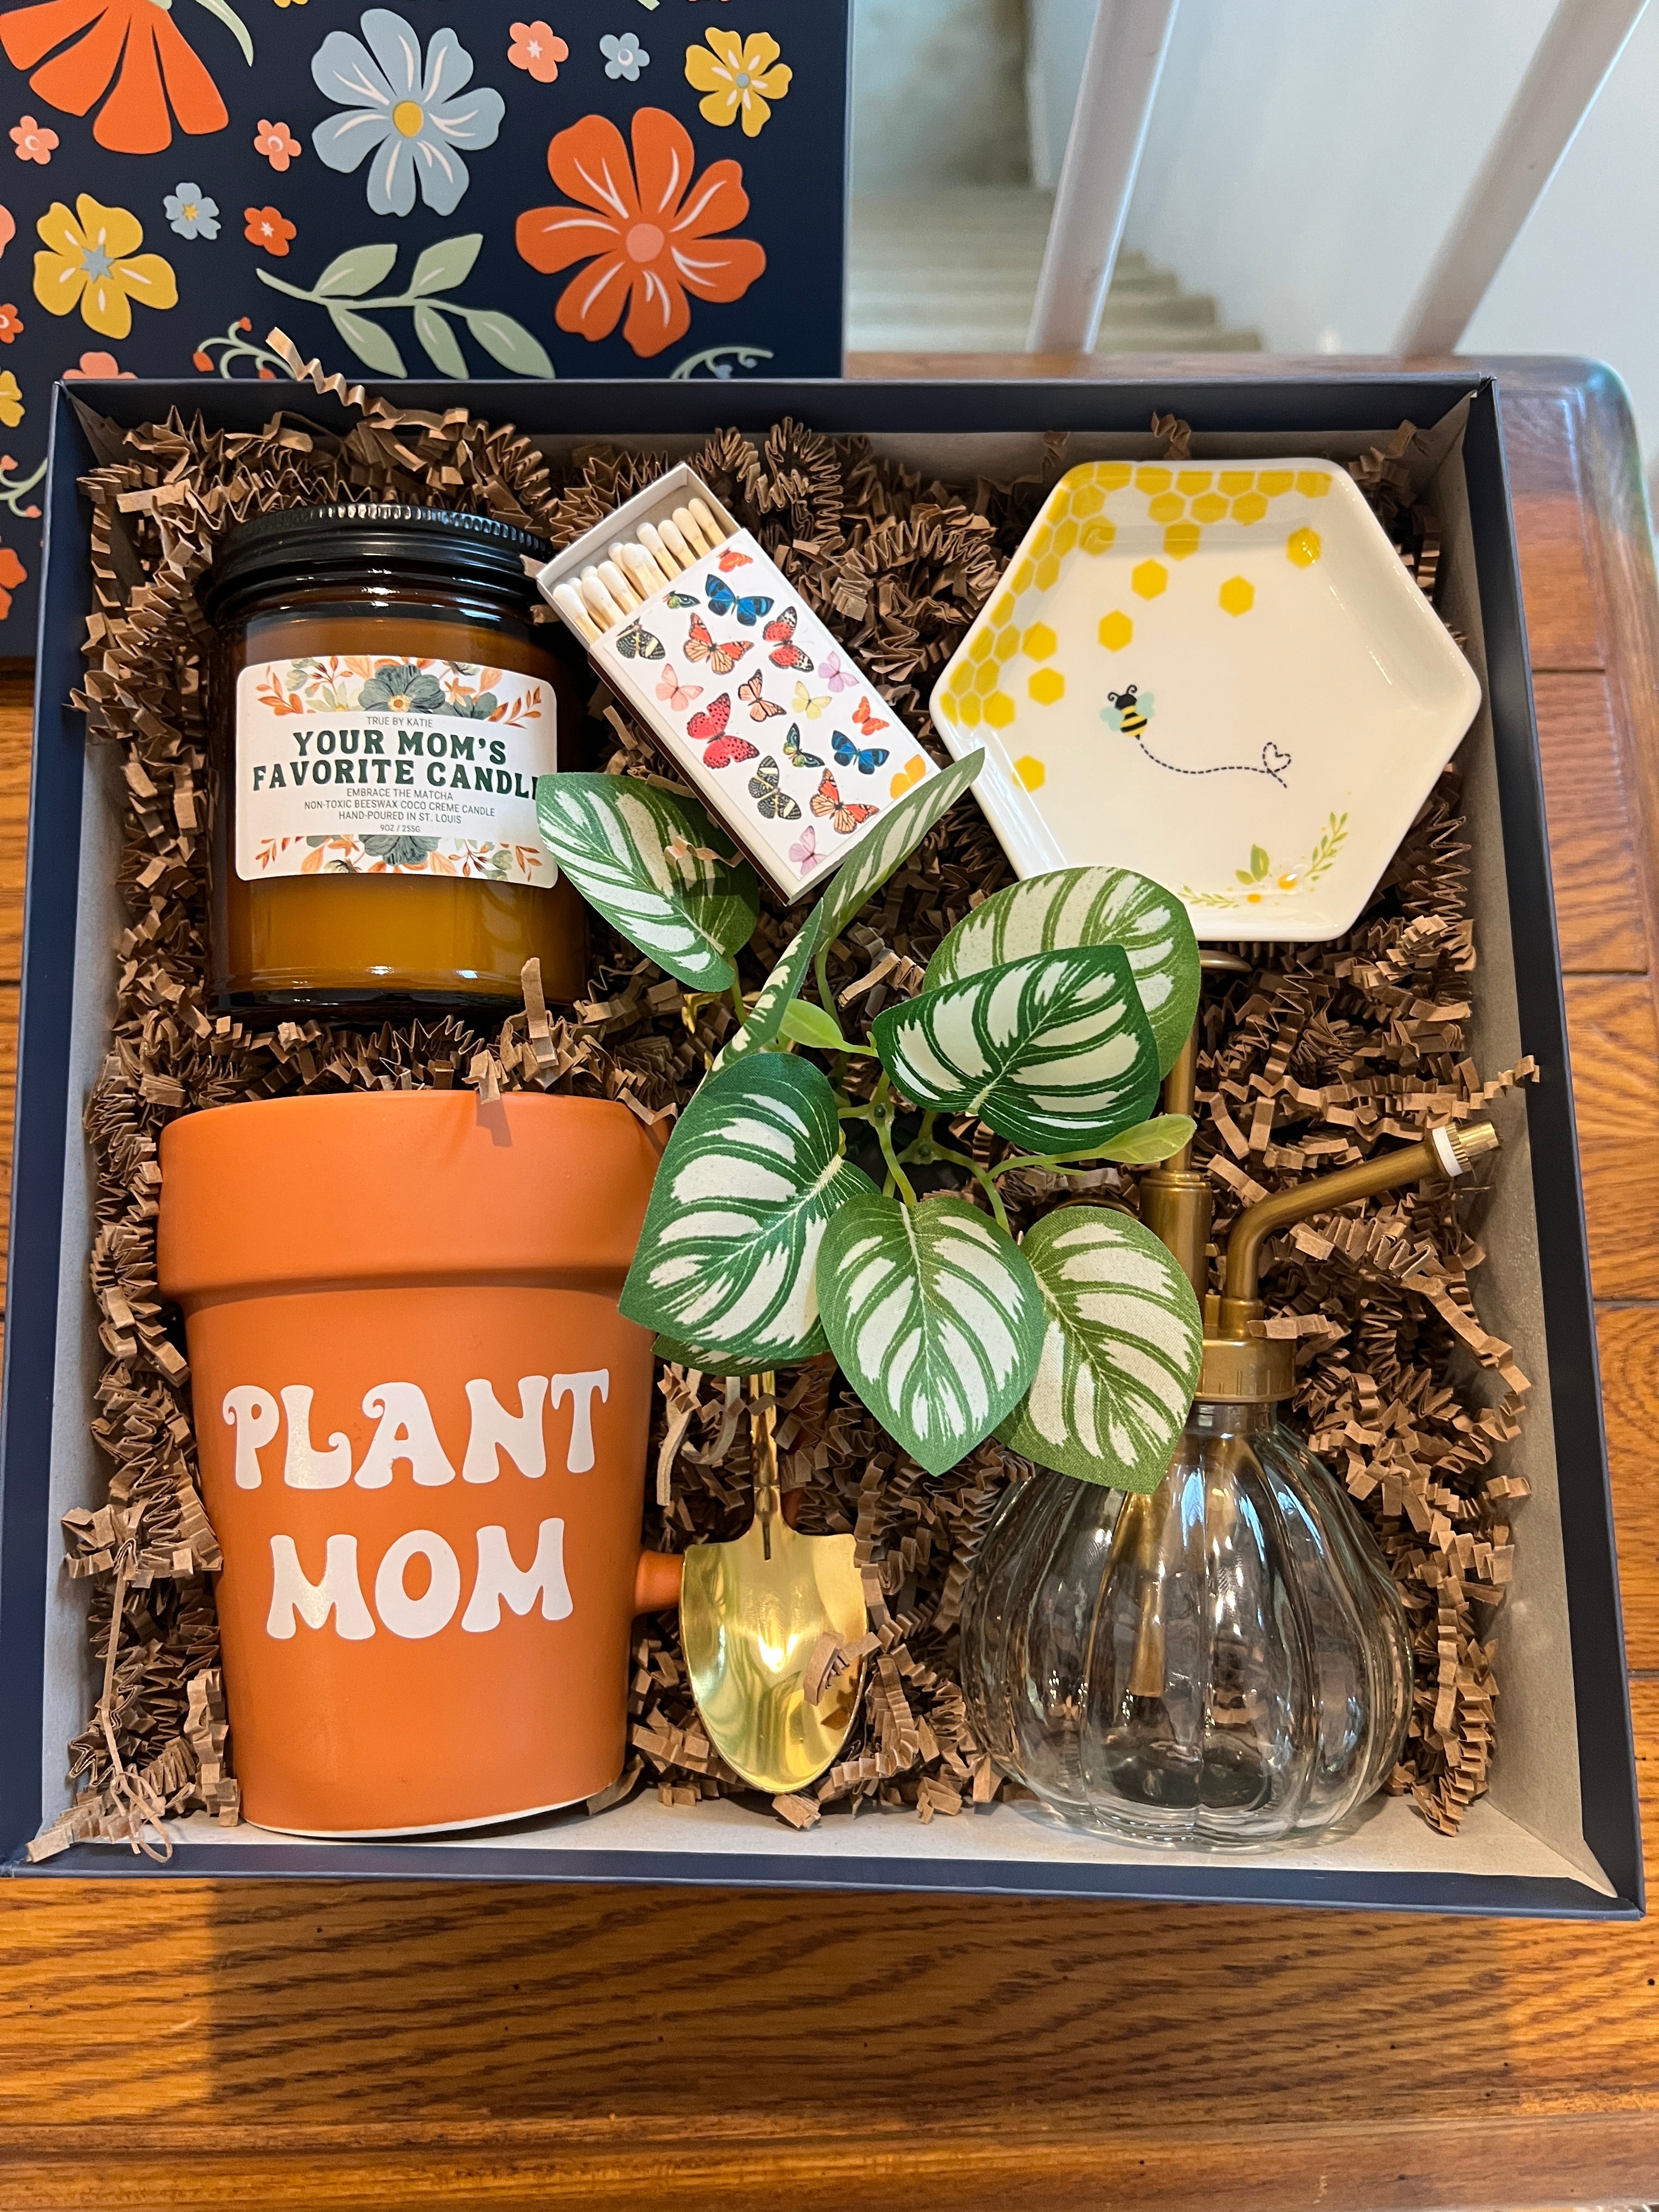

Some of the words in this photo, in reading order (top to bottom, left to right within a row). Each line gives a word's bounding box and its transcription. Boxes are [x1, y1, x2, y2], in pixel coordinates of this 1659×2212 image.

[367, 716, 390, 725] TRUE
[393, 717, 404, 726] BY
[407, 718, 433, 727] KATIE
[293, 730, 385, 757] YOUR
[398, 730, 506, 765] MOM'S
[253, 759, 414, 791] FAVORITE
[347, 788, 390, 797] EMBRACE
[393, 789, 411, 798] THE
[414, 790, 453, 800] MATCHA
[304, 800, 352, 809] NON-TOXIC
[354, 800, 398, 809] BEESWAX
[401, 801, 426, 810] COCO
[429, 802, 459, 812] CREME
[462, 805, 495, 816] CANDLE
[339, 811, 404, 820] HAND-POURED
[407, 812, 416, 821] IN
[419, 813, 433, 822] ST.
[436, 814, 461, 823] LOUIS
[223, 1368, 610, 1489] PLANT
[266, 1517, 574, 1640] MOM
